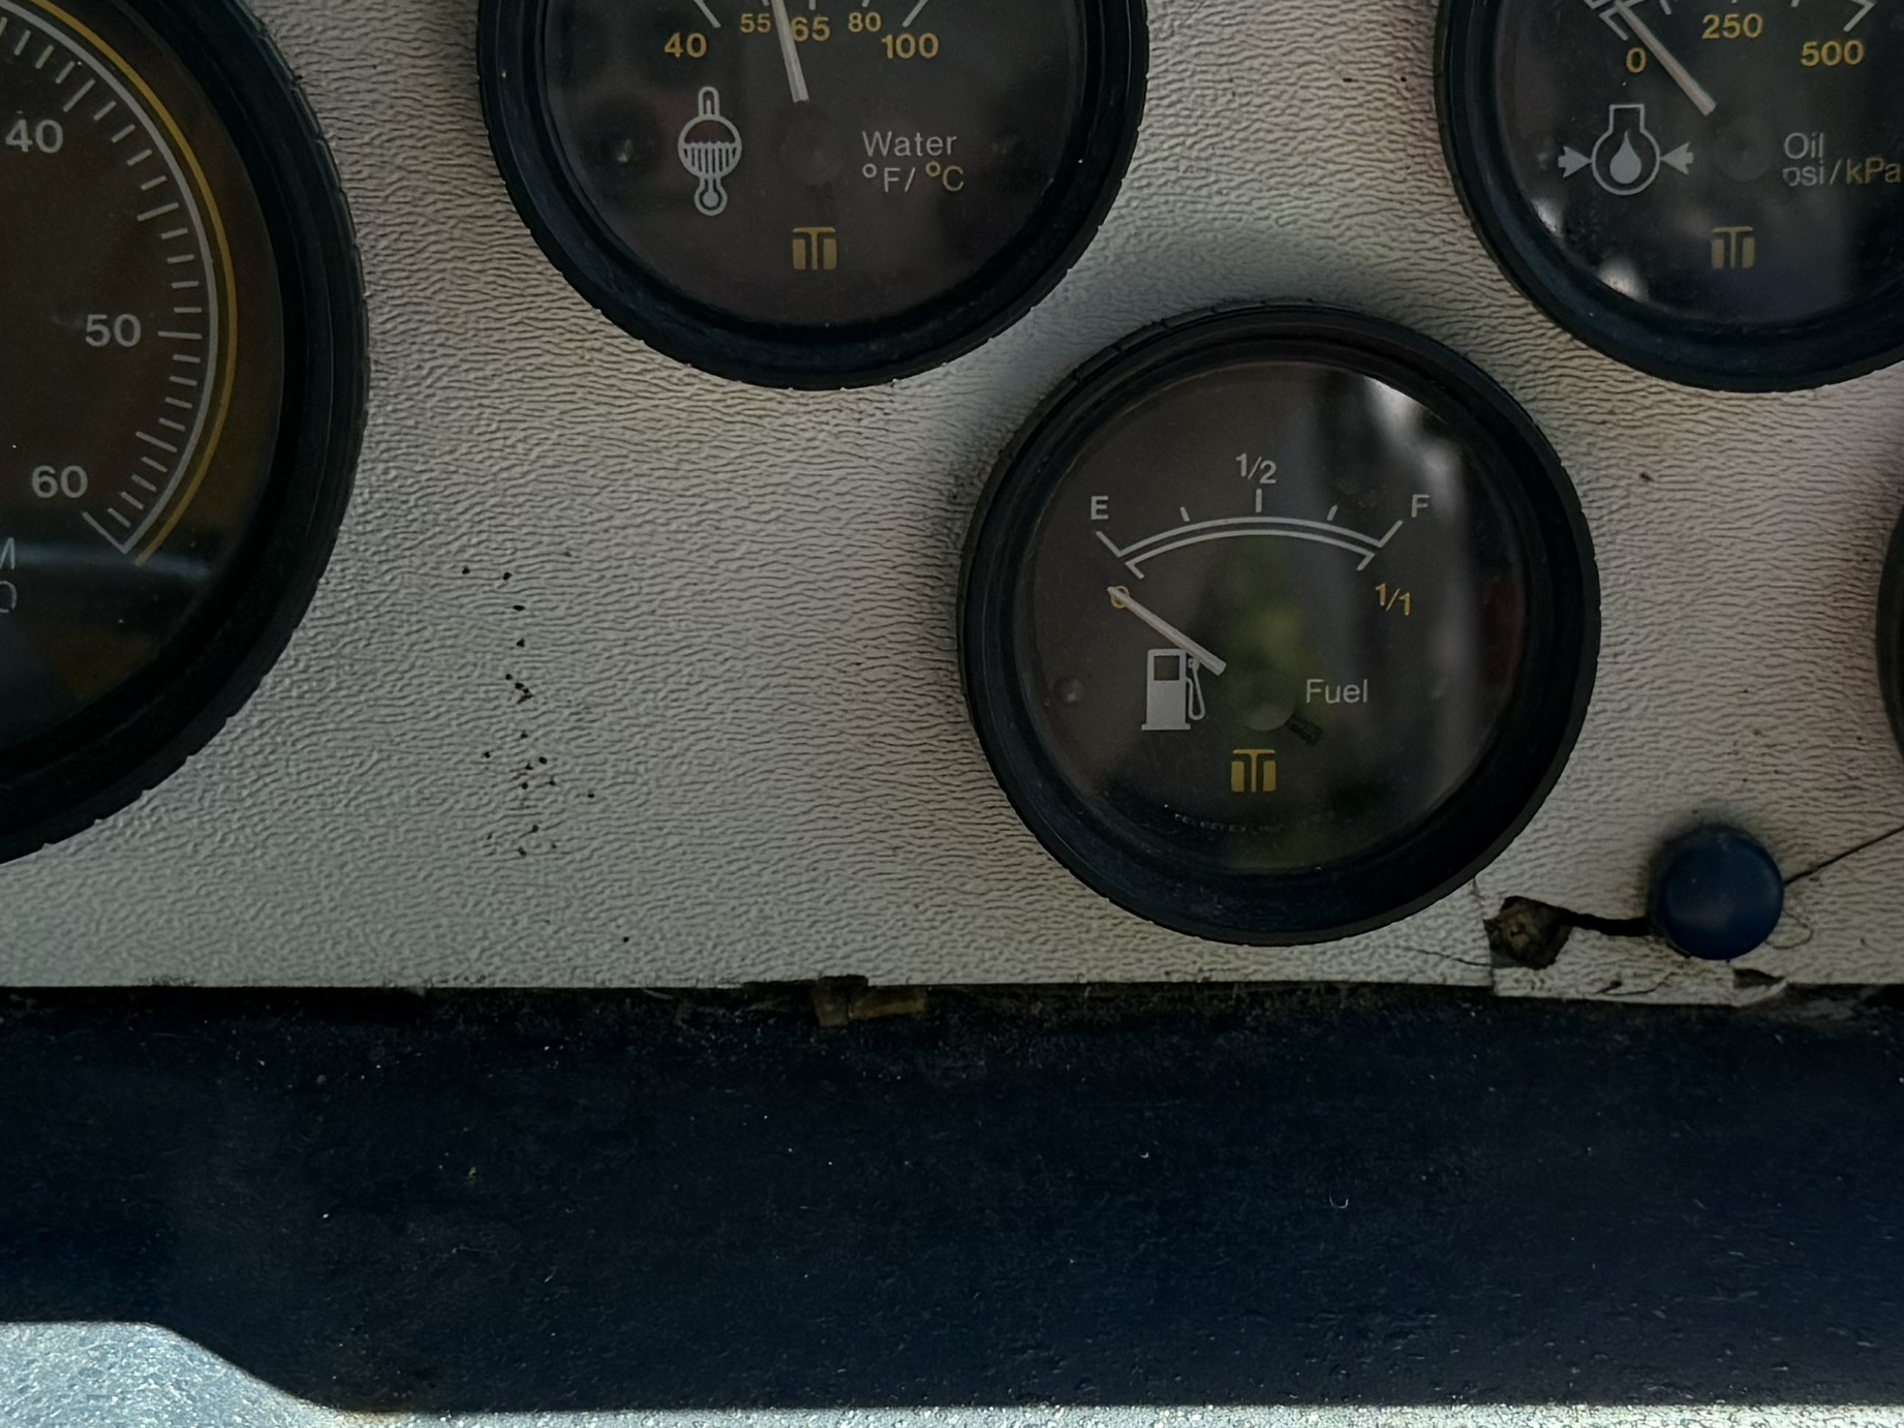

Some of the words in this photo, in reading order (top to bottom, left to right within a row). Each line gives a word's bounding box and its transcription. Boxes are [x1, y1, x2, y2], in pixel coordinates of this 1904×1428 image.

[740, 13, 772, 33] 55
[792, 16, 831, 43] 65
[847, 12, 882, 32] 80
[1702, 14, 1764, 39] 250
[663, 33, 707, 59] 40
[881, 34, 939, 60] 100
[1800, 41, 1864, 66] 500
[1625, 48, 1648, 74] 0
[4, 119, 64, 156] 40
[862, 131, 957, 157] Water
[1783, 132, 1825, 160] Oil
[85, 313, 141, 350] 50
[1236, 453, 1277, 485] 1/2
[31, 465, 88, 500] 60
[1090, 496, 1109, 520] E
[1410, 493, 1431, 518] F
[1375, 583, 1412, 617] 1/1
[1305, 678, 1368, 704] Fuel
